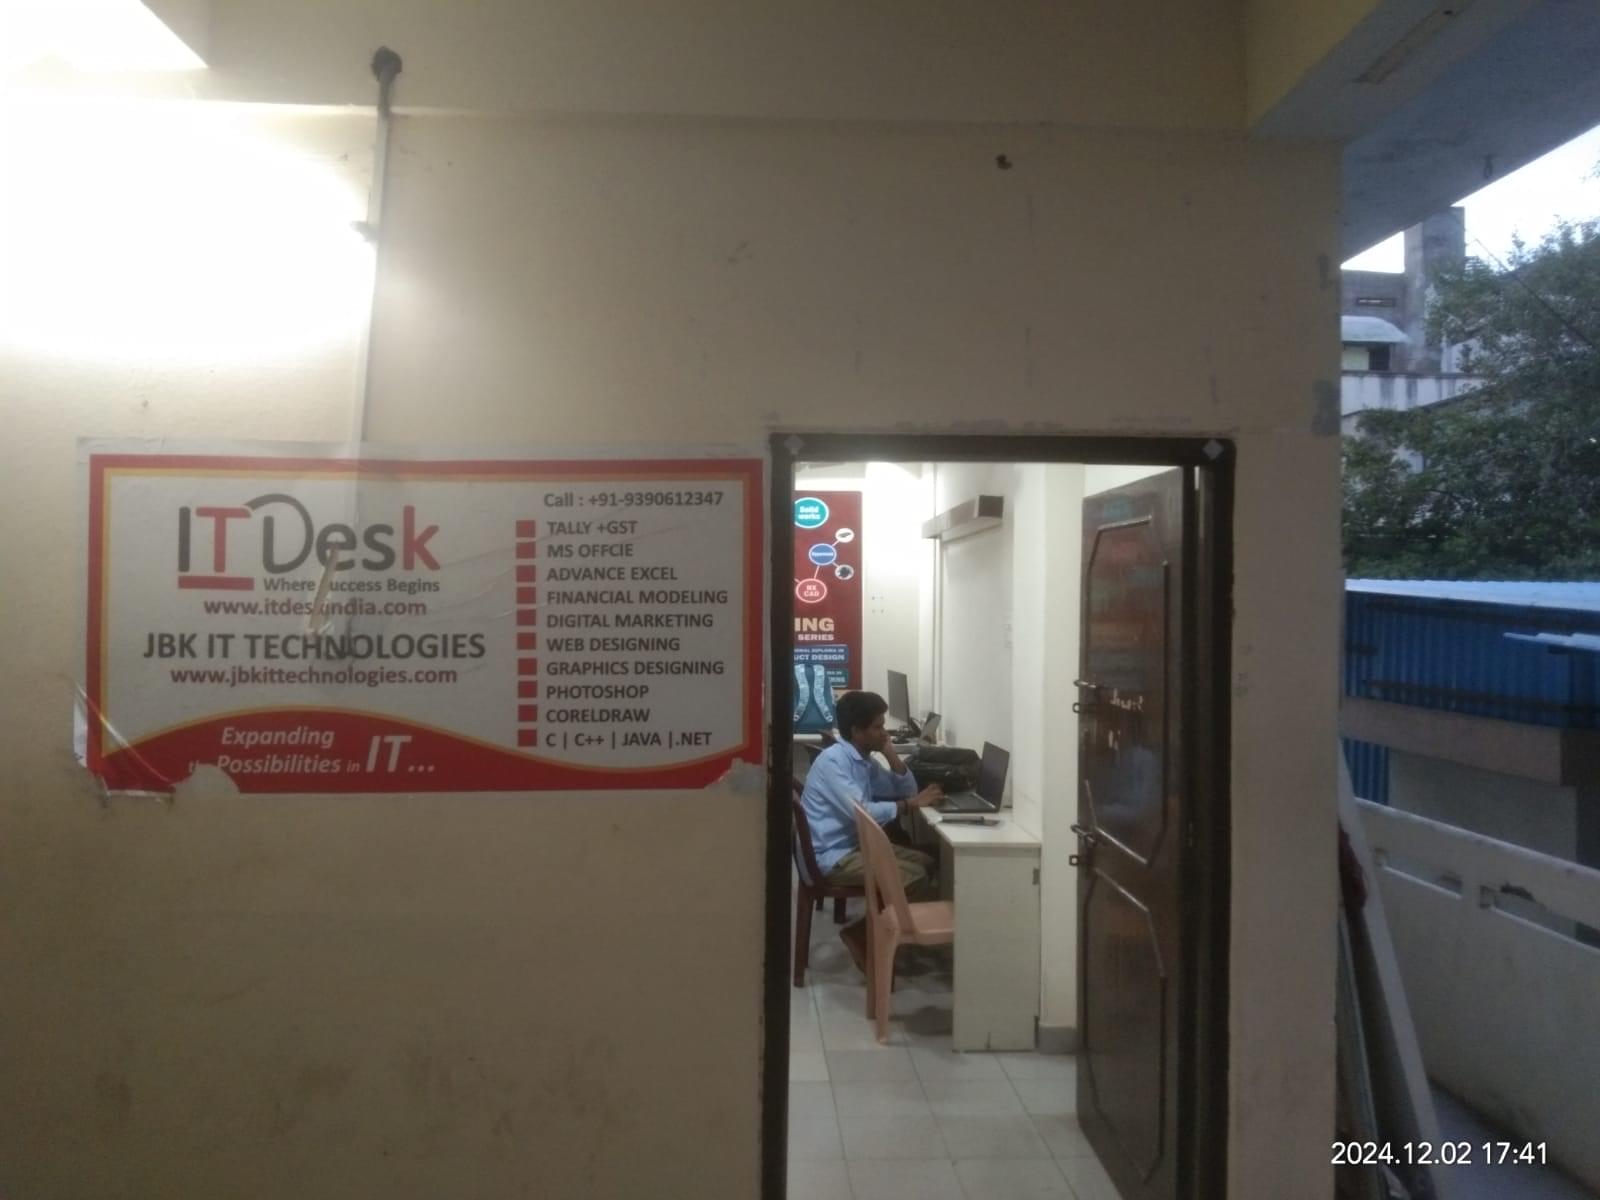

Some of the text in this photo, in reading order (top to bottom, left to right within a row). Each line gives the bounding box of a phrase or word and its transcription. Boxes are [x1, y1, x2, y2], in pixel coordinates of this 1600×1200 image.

[543, 493, 574, 507] Call
[588, 492, 724, 506] +91-9390612347
[177, 493, 441, 575] IT Desk
[546, 520, 638, 535] TALLY +GST
[546, 543, 634, 558] MS OFFCIE
[546, 566, 678, 581] ADVANCE EXCEL
[264, 578, 440, 595] Where uccess Begins
[546, 590, 728, 604] FINANCIAL MODELING
[204, 598, 427, 616] www.itdesindia.com
[546, 613, 714, 628] DIGITAL MARKETING
[143, 633, 485, 660] JBK IT TECHNOLOGIES
[546, 637, 680, 651] WEB DESIGNING
[546, 660, 724, 676] GRAPHICS DESIGNING
[171, 667, 457, 687] www.jbkittechnologies.com
[546, 685, 649, 699] PHOTOSHOP
[546, 709, 650, 723] CORELDRAW
[221, 726, 335, 749] Expanding
[546, 733, 557, 747] C
[574, 733, 605, 747] C++
[622, 732, 662, 746] JAVA
[217, 754, 340, 774] Possibilities
[346, 761, 360, 772] in
